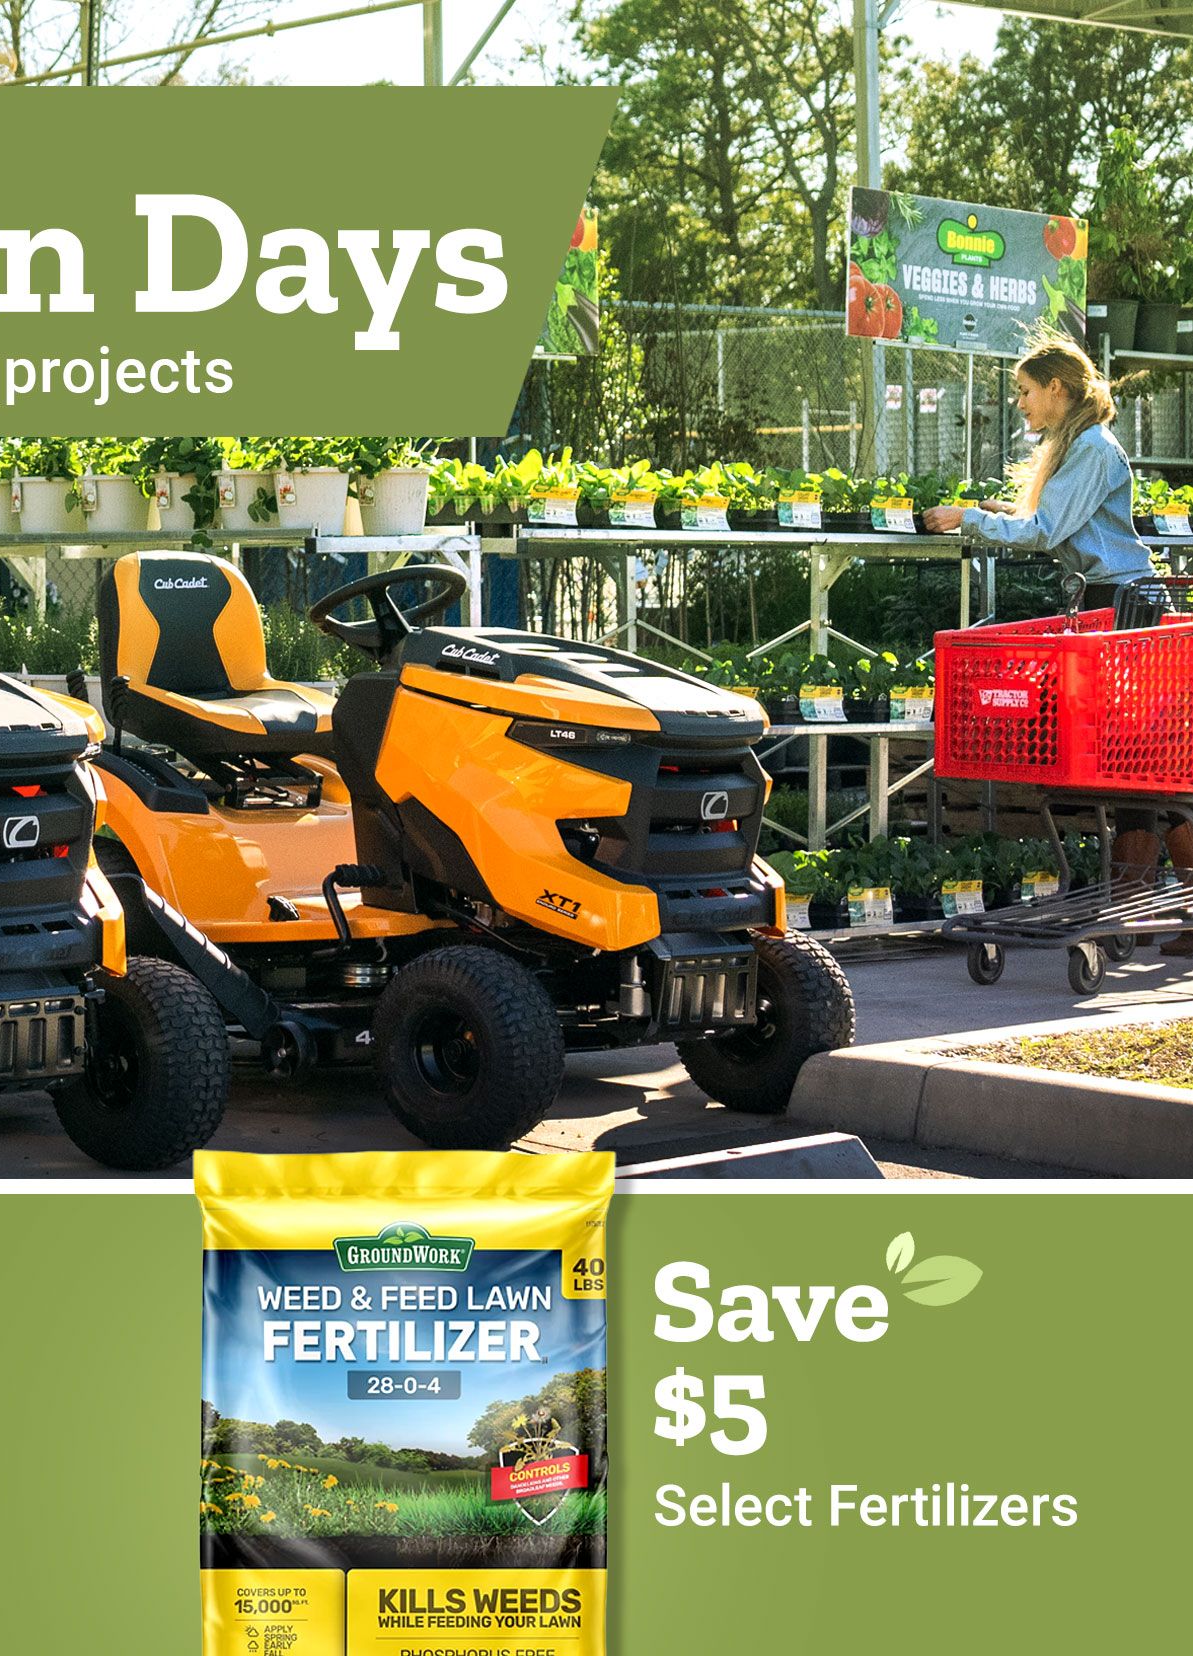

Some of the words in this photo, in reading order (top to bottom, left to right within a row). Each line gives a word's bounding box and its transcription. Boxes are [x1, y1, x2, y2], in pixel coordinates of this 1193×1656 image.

[947, 230, 995, 254] Bonnie
[961, 254, 983, 263] PLANTS
[902, 264, 968, 297] VEGGIES
[972, 273, 984, 299] &
[989, 275, 1037, 306] HERBS
[154, 577, 174, 590] Cub
[174, 576, 208, 589] Cadet
[441, 644, 463, 658] Cub
[462, 648, 500, 666] Cadet
[992, 690, 1028, 699] TRACTOR
[992, 698, 1019, 707] SUPPLY
[550, 729, 576, 740] LT46
[539, 889, 582, 913] XT1
[573, 1258, 605, 1276] 40
[574, 1279, 604, 1291] LBS
[258, 1286, 342, 1311] WEED
[350, 1286, 373, 1311] &
[381, 1286, 458, 1311] FEED
[467, 1286, 552, 1311] LAWN
[263, 1320, 542, 1363] FERTILIZER
[367, 1377, 442, 1395] 28-0-4
[509, 1462, 571, 1483] CONTROLS
[237, 1588, 276, 1597] COVERS
[278, 1588, 292, 1597] UP
[293, 1588, 307, 1597] TO
[234, 1599, 292, 1615] 15,000
[378, 1588, 467, 1614] KILLS
[473, 1588, 582, 1614] WEEDS
[264, 1625, 294, 1634] APPLY
[378, 1616, 424, 1628] WHILE
[427, 1616, 492, 1628] FEEDING
[495, 1616, 536, 1628] YOUR
[539, 1616, 582, 1628] LAWN
[264, 1633, 298, 1642] SPRING
[264, 1641, 293, 1650] EARLY
